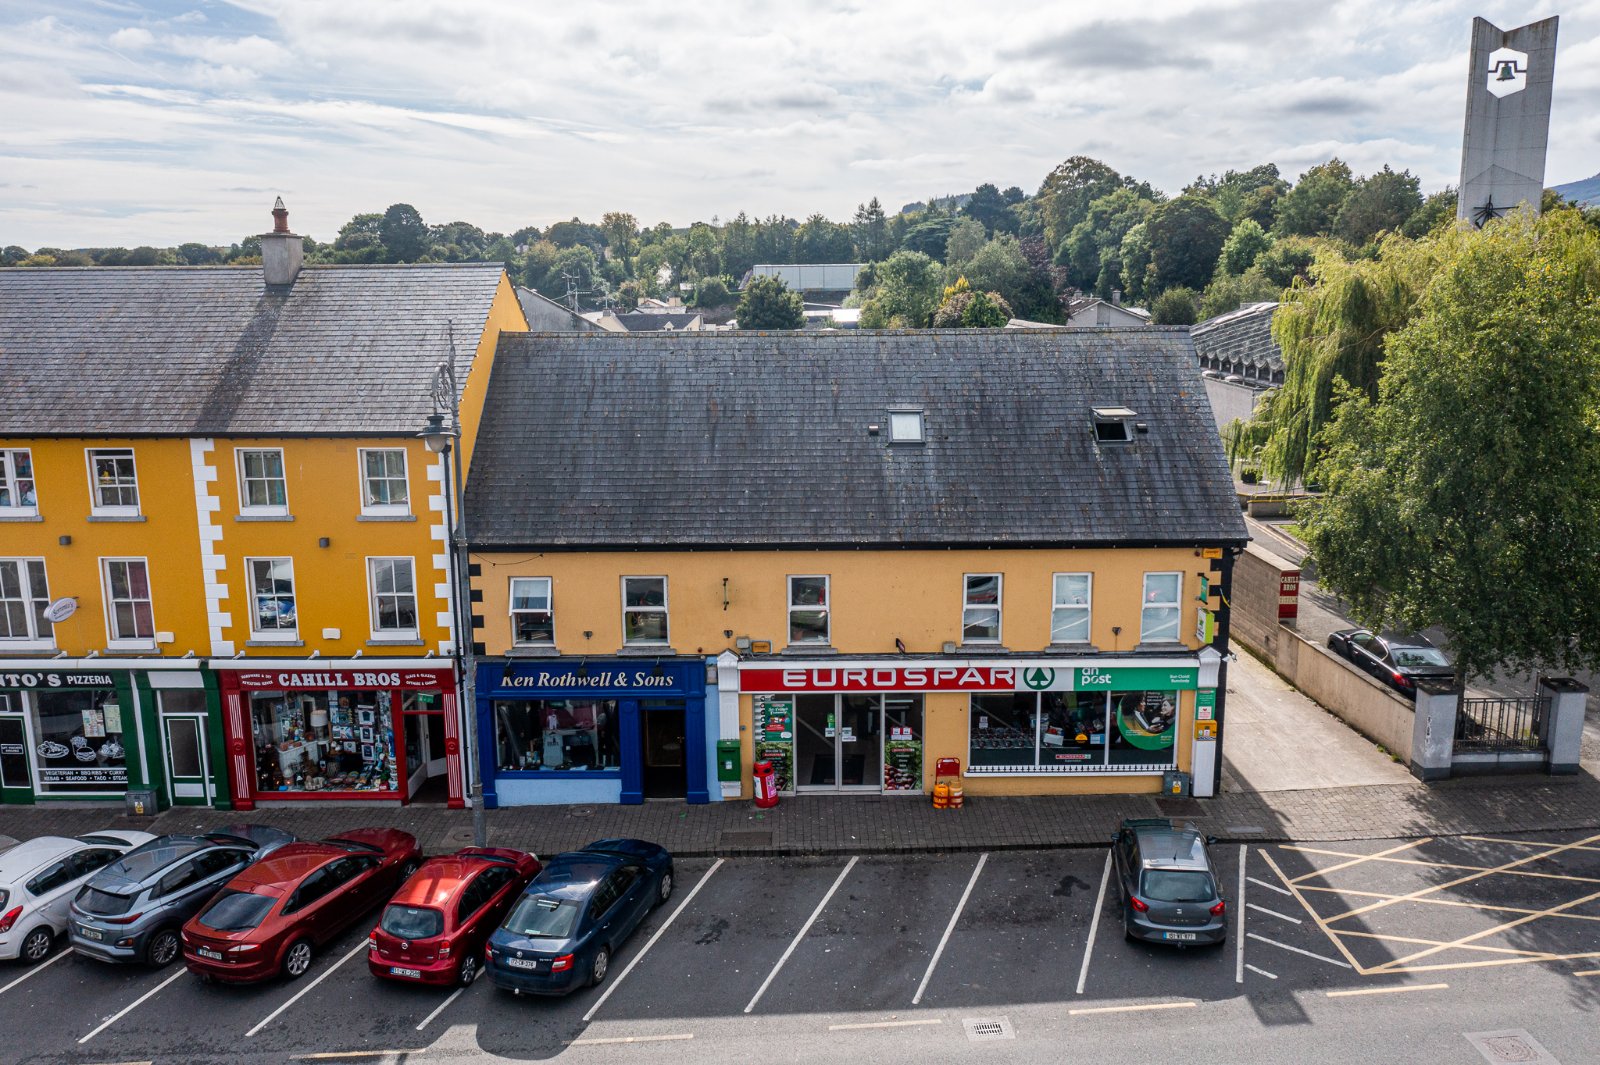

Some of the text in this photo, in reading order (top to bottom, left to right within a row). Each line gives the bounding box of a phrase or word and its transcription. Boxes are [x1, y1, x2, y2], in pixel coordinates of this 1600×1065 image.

[783, 668, 1014, 687] EUROSPAR
[1081, 667, 1099, 676] an
[66, 675, 113, 685] PIZZERIA
[278, 672, 401, 687] CAHILL BROS
[501, 672, 674, 687] Ken Rothwell & Sons
[1081, 674, 1112, 686] post
